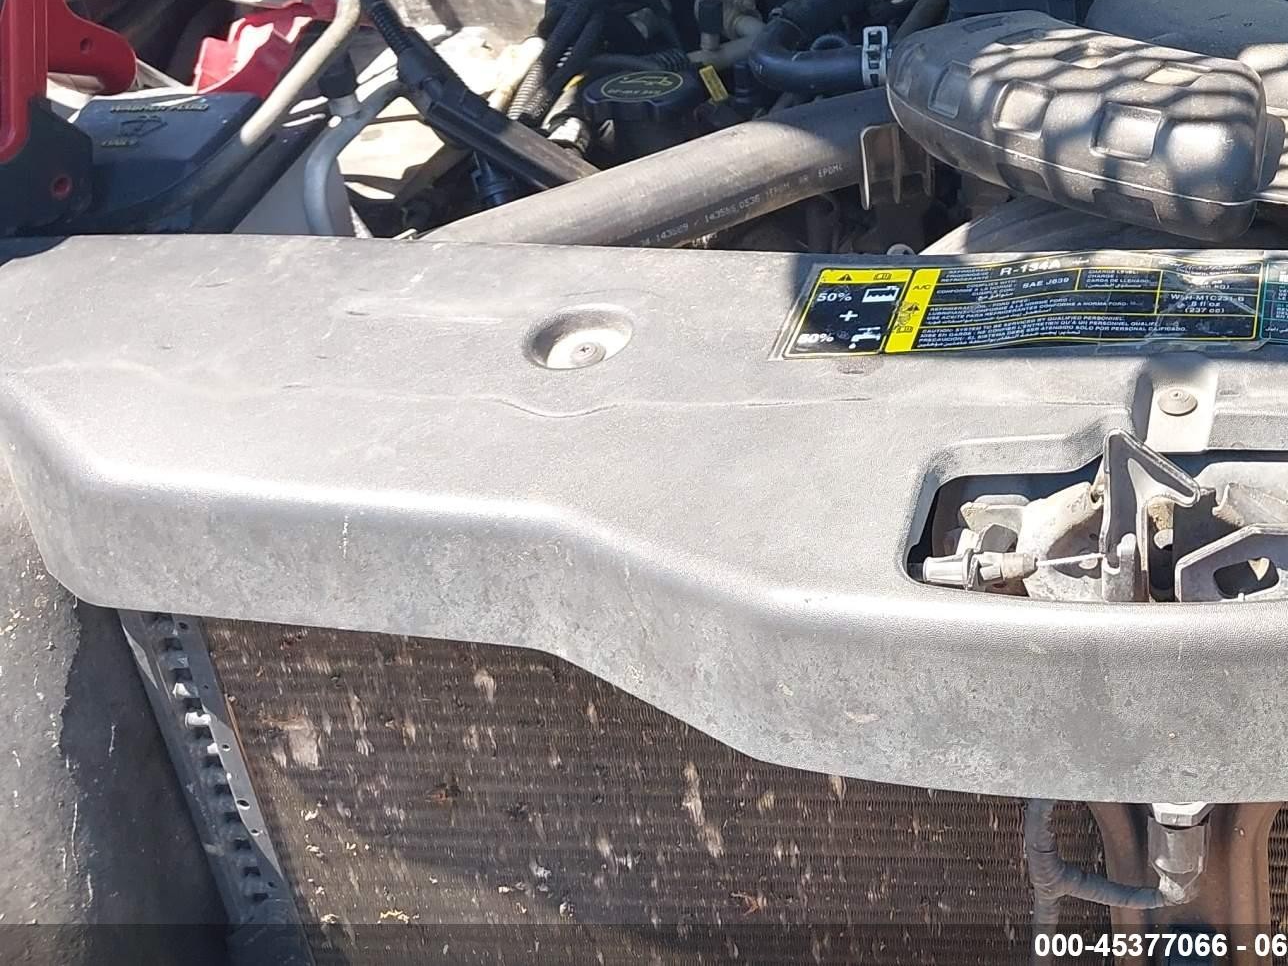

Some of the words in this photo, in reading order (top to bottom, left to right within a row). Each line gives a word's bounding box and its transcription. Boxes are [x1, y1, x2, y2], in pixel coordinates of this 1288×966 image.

[1000, 259, 1061, 276] R-134A
[1022, 281, 1043, 289] SAE
[816, 292, 852, 302] 50%
